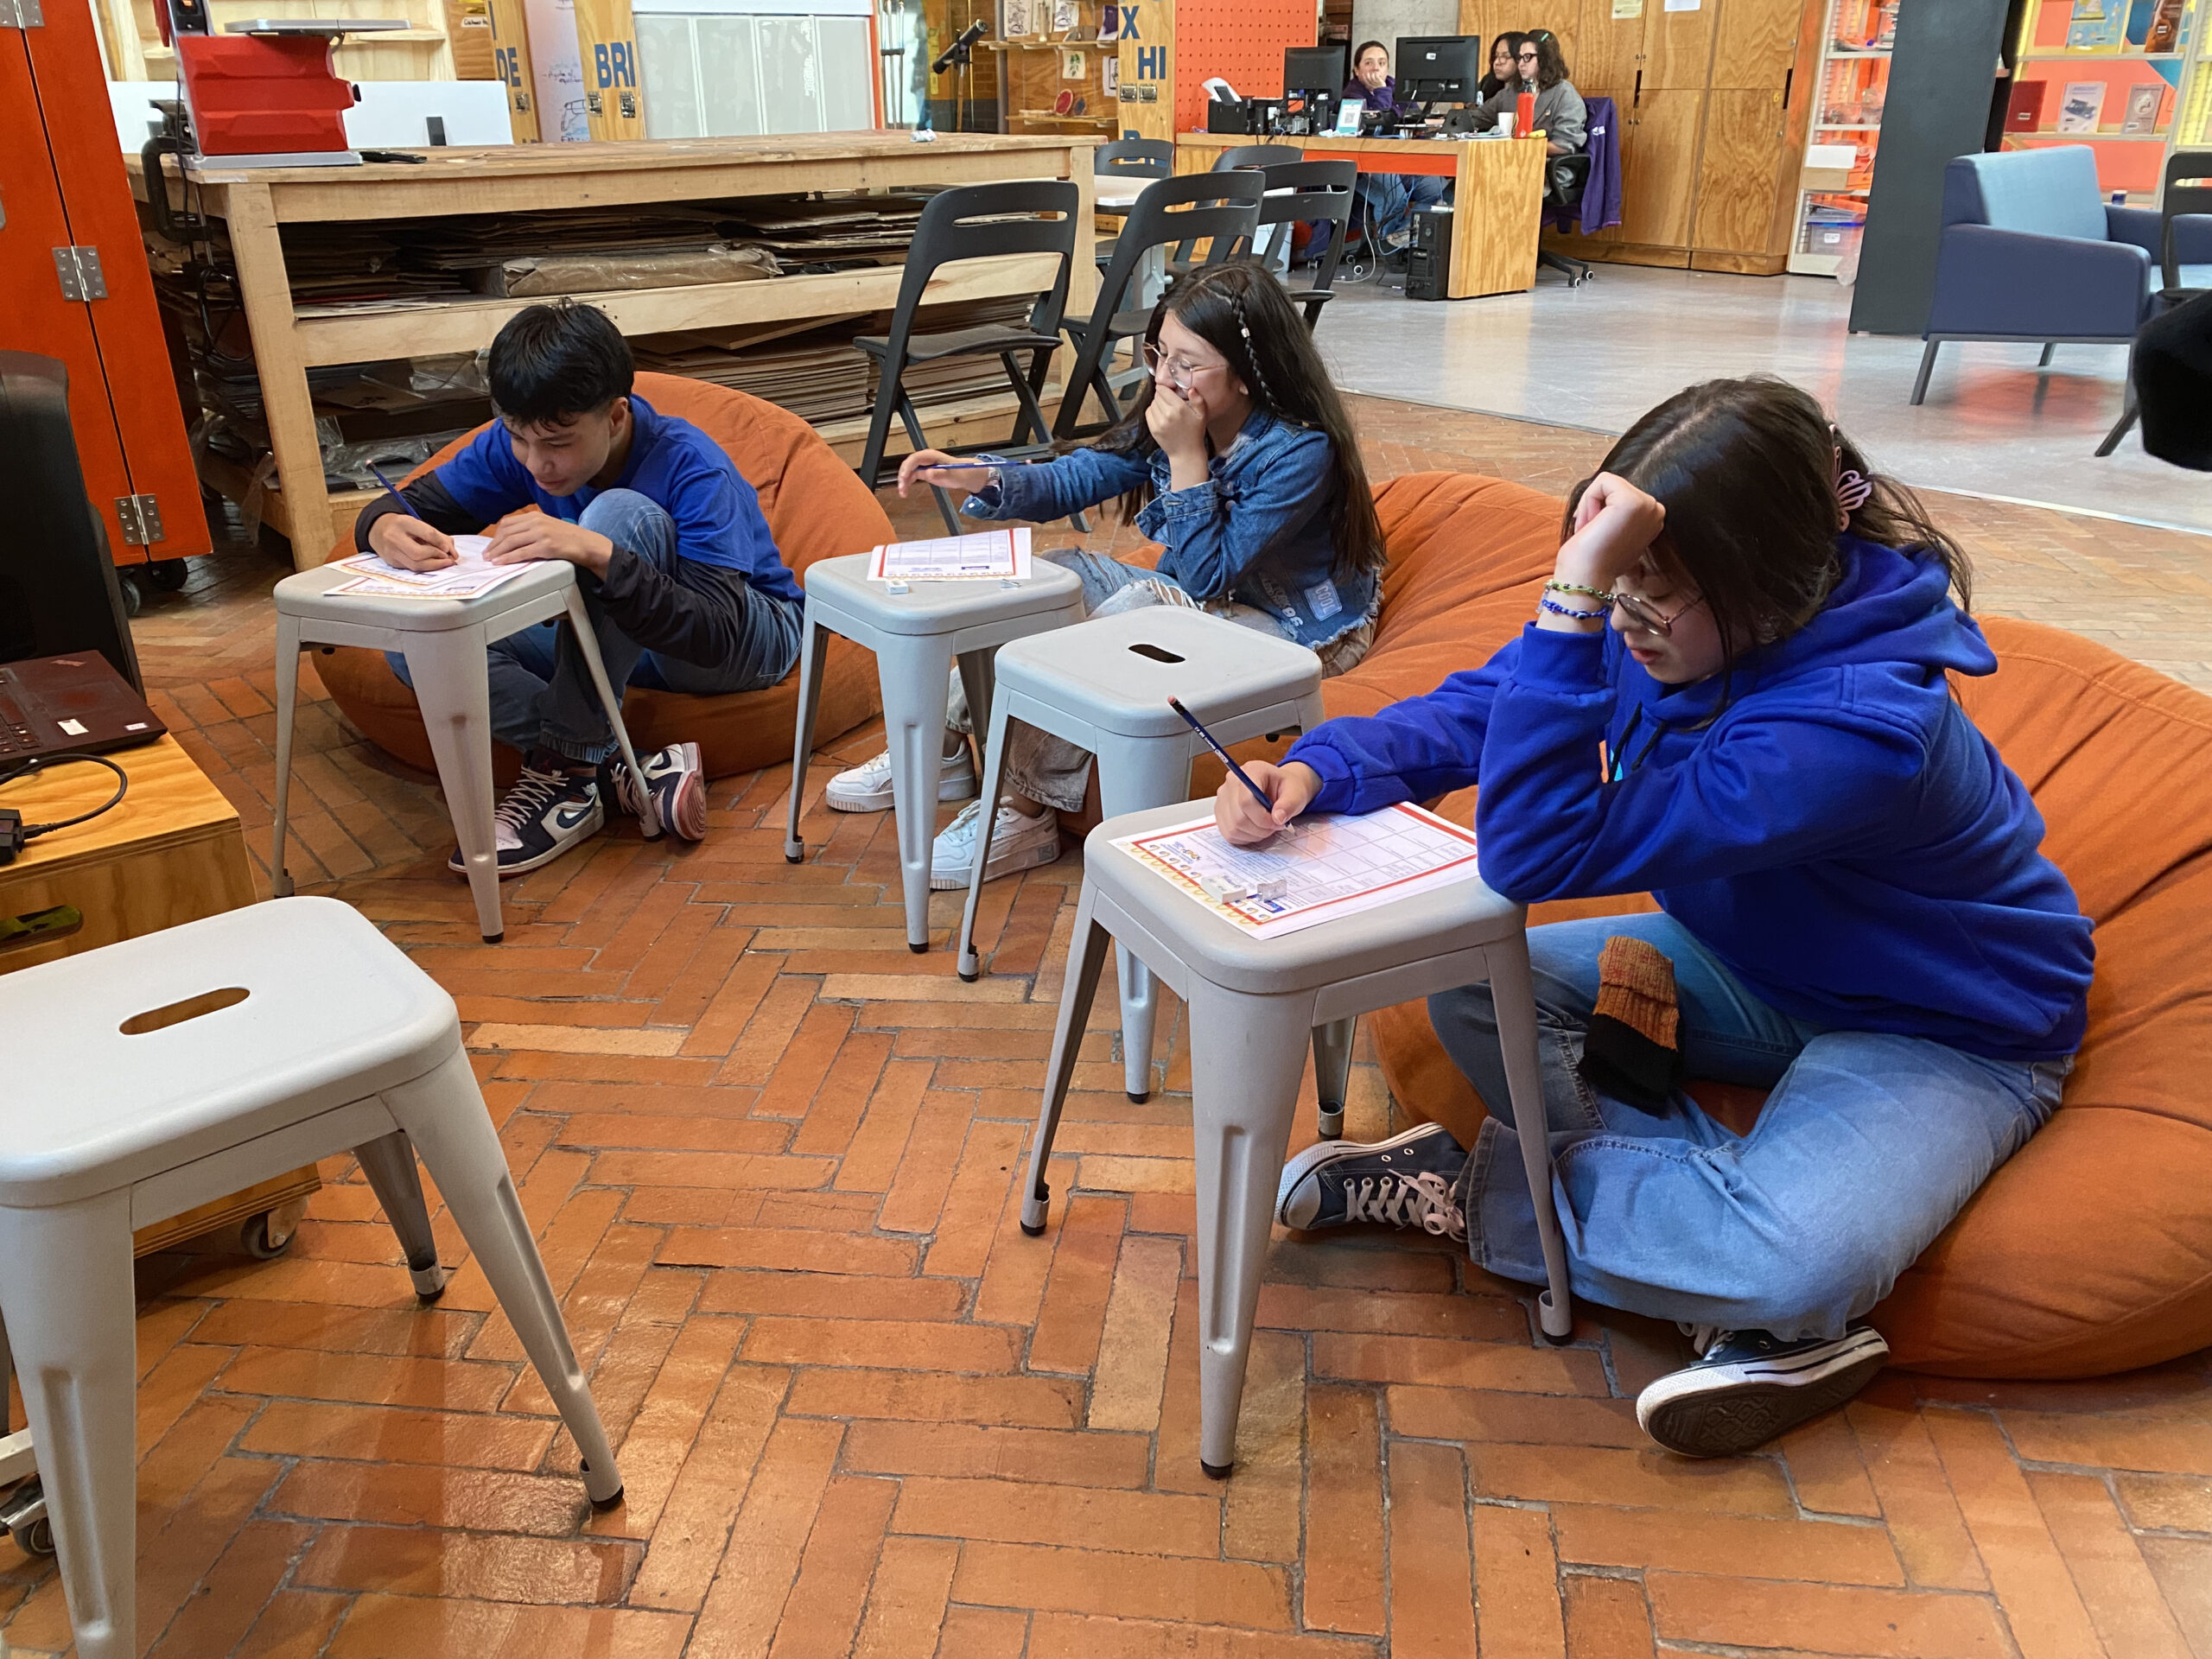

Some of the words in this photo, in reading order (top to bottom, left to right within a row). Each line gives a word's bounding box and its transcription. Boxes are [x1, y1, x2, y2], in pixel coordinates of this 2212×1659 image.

[1120, 5, 1141, 40] X
[495, 47, 521, 87] DE
[594, 41, 637, 88] BRI
[1138, 46, 1166, 79] HI
[1315, 585, 1336, 614] COOL
